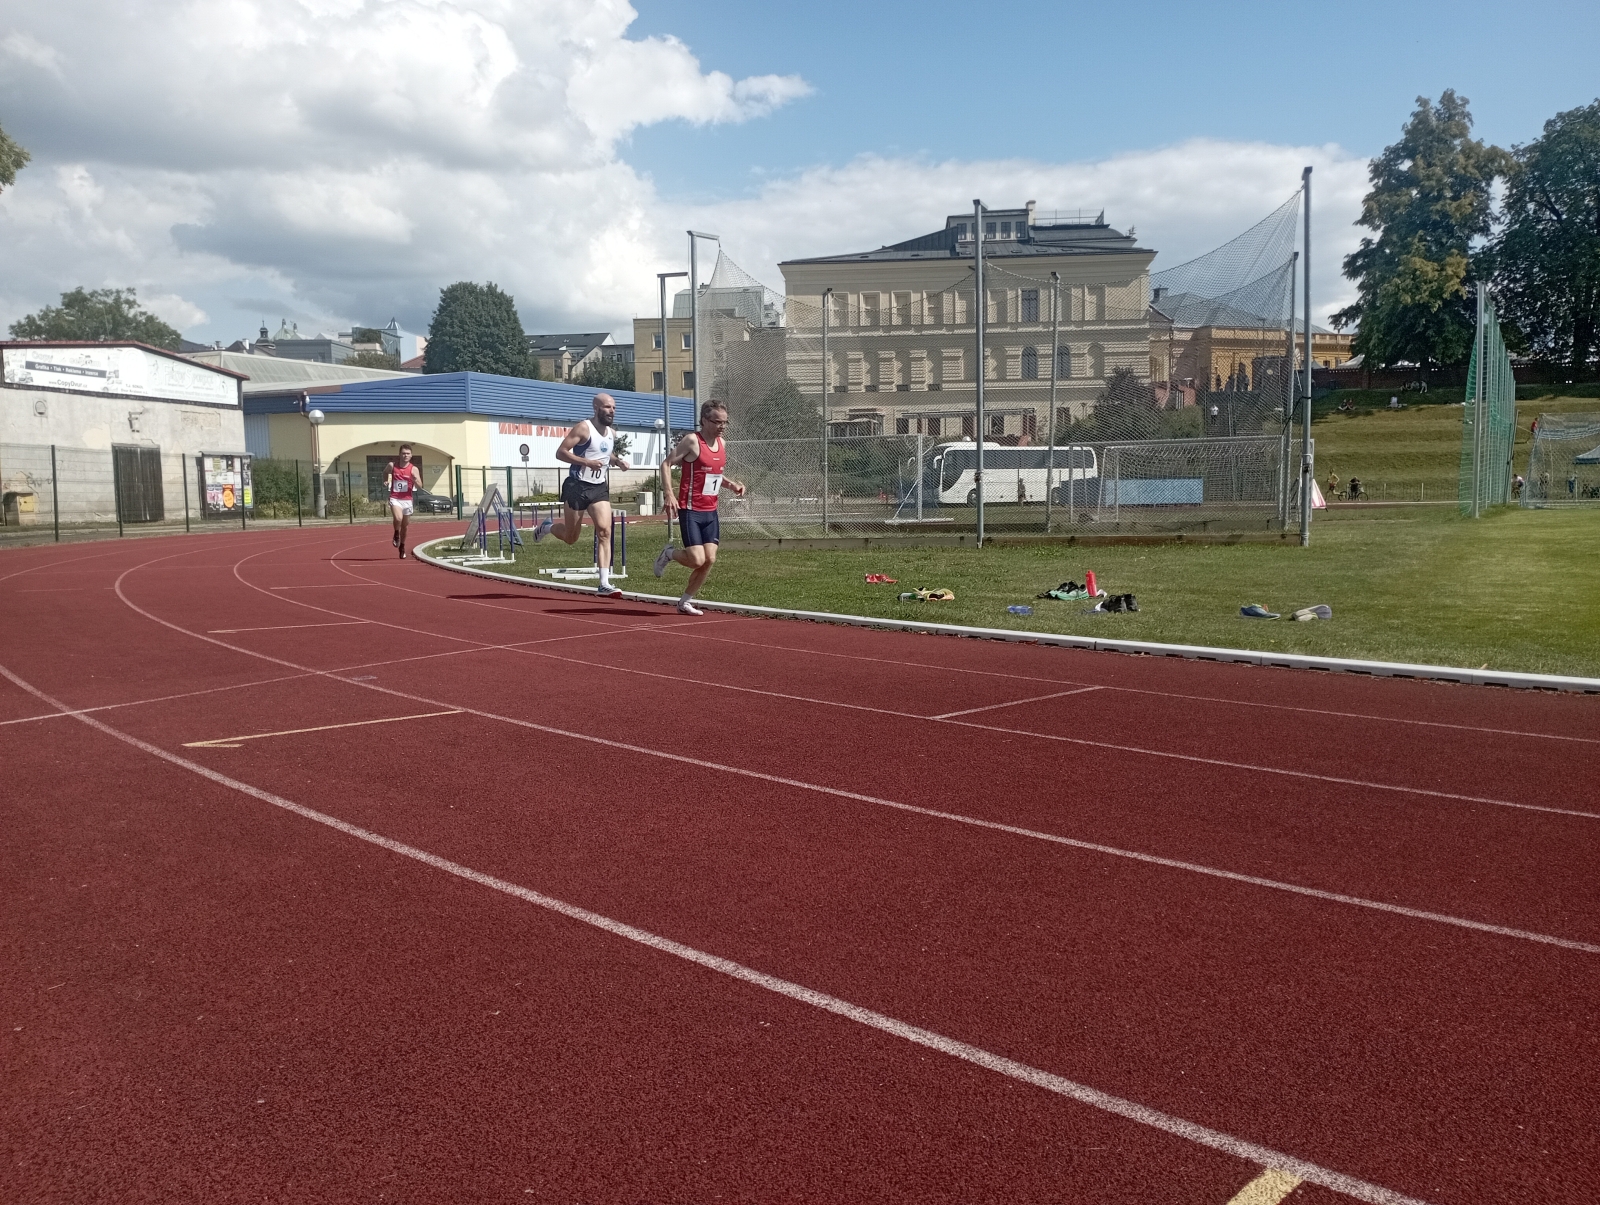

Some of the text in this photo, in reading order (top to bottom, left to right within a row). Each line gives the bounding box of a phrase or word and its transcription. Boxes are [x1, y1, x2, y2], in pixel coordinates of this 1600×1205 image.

[590, 468, 602, 479] 10
[397, 482, 403, 490] 9
[712, 479, 718, 491] 1
